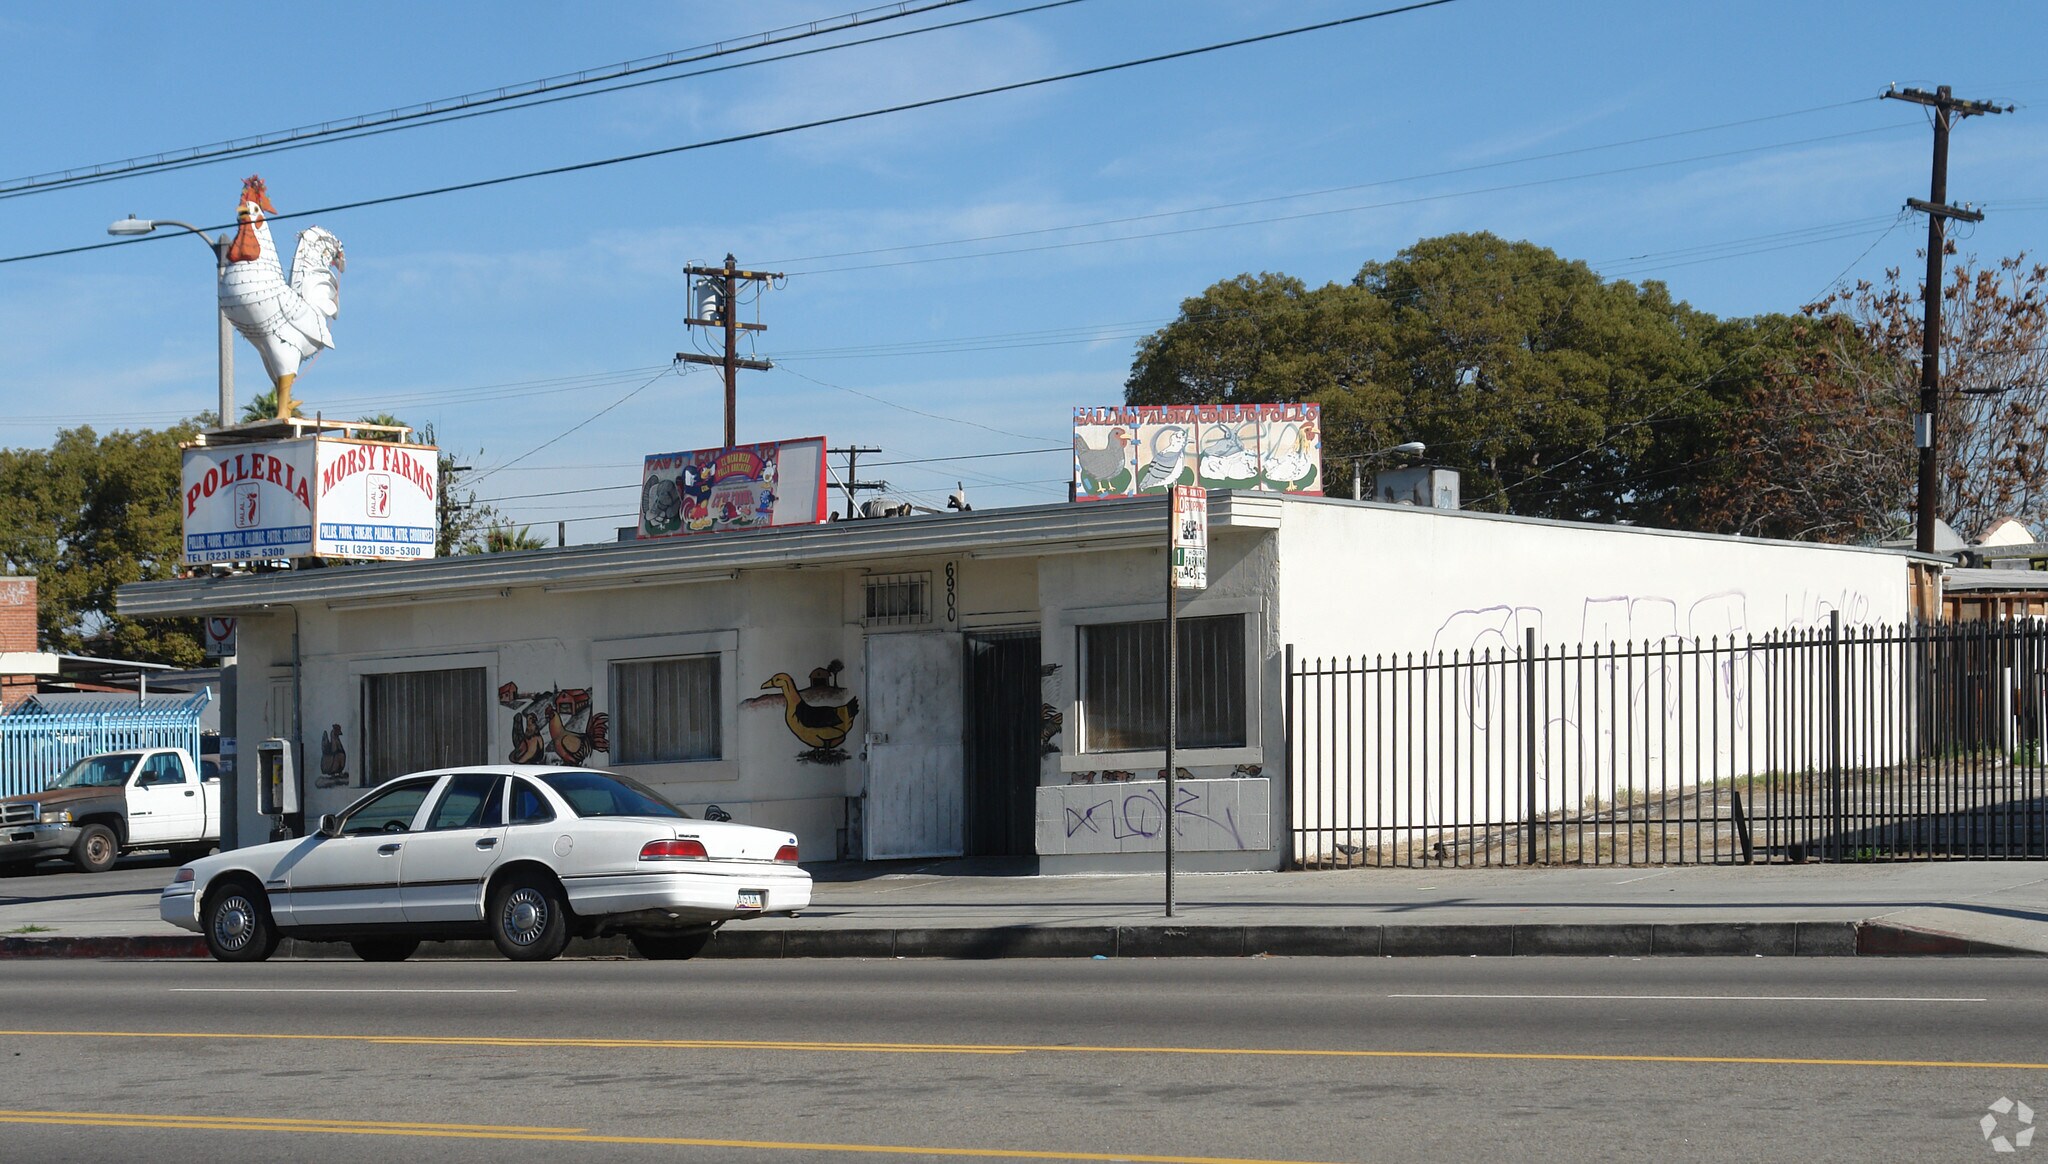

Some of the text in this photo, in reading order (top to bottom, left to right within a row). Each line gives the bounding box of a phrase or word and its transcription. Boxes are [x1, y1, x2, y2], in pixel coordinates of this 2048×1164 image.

[1140, 409, 1198, 424] PALOMA
[1199, 408, 1257, 422] CONEJO
[1259, 407, 1317, 422] POLLO
[322, 445, 432, 501] MORSY FARMS
[187, 453, 310, 519] POLLERIA
[187, 554, 202, 562] TEL
[235, 550, 251, 558] 585
[262, 547, 284, 556] 5300
[335, 545, 420, 556] TEL (323) 585-5300
[1186, 556, 1205, 568] PARKING
[946, 562, 955, 622] 6900
[217, 642, 222, 654] 3
